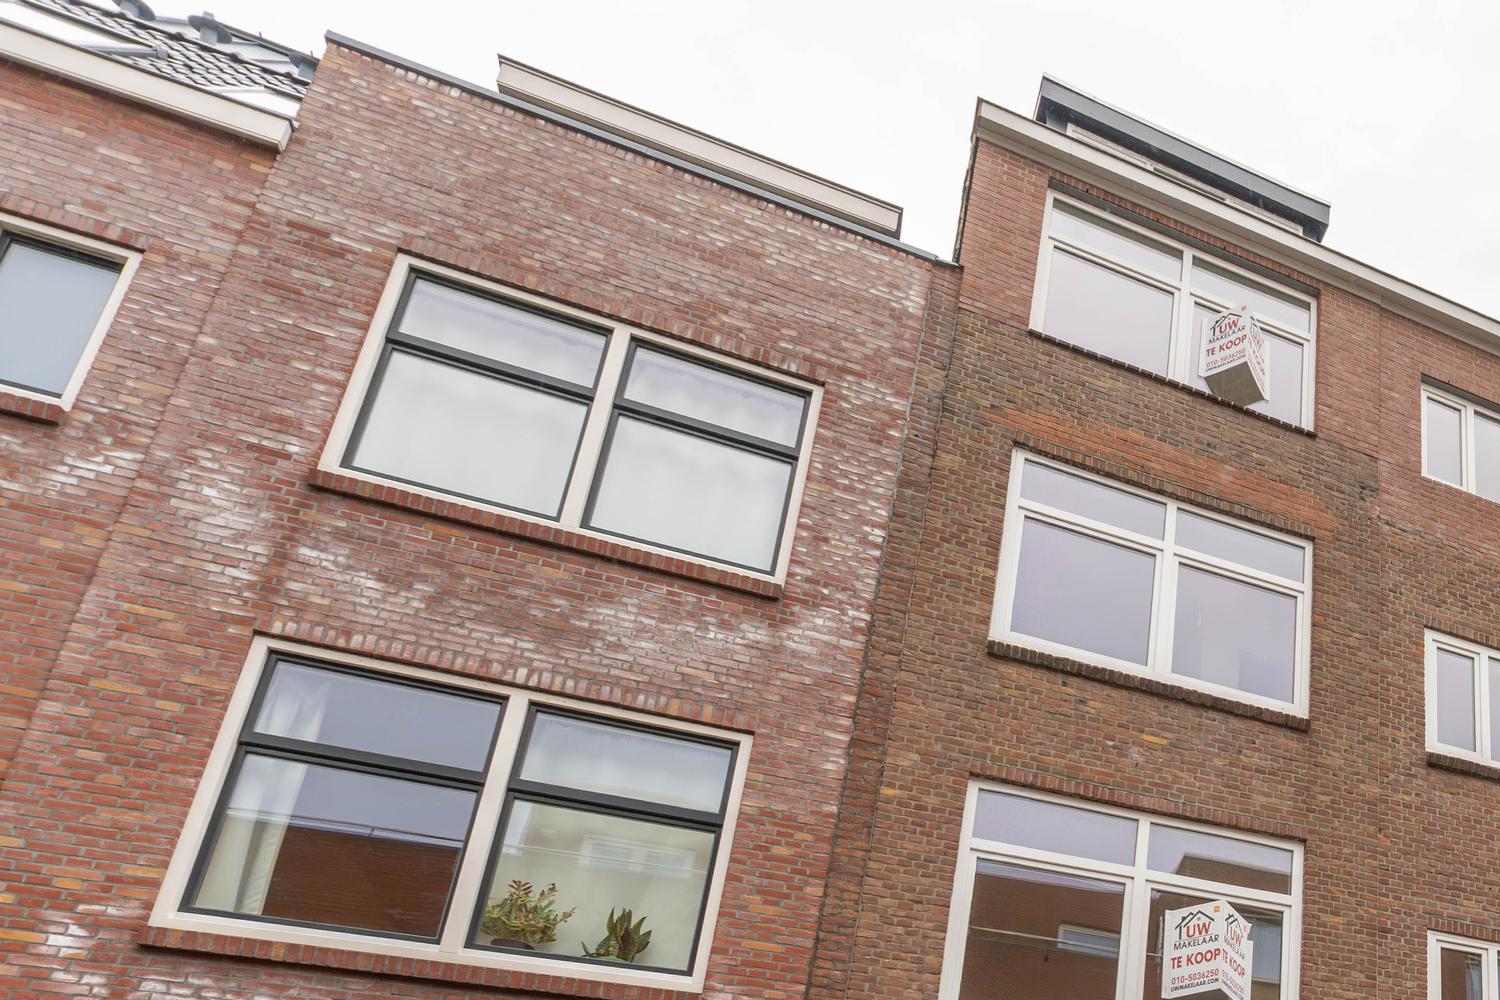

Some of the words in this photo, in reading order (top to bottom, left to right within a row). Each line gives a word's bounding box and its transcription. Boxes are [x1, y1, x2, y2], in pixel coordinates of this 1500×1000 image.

[1219, 318, 1240, 334] UW
[1205, 346, 1216, 357] TE
[1219, 334, 1247, 352] KOOP
[1186, 921, 1211, 938] UW
[1230, 926, 1243, 946] UW
[1173, 934, 1219, 951] MAKELAAR
[1170, 956, 1182, 969] TE
[1186, 948, 1221, 967] KOOP
[1222, 948, 1228, 963] TE
[1229, 955, 1245, 977] KOOP
[1170, 977, 1219, 992] UWMAKELAAR.COM
[1171, 968, 1219, 985] 010-5036250
